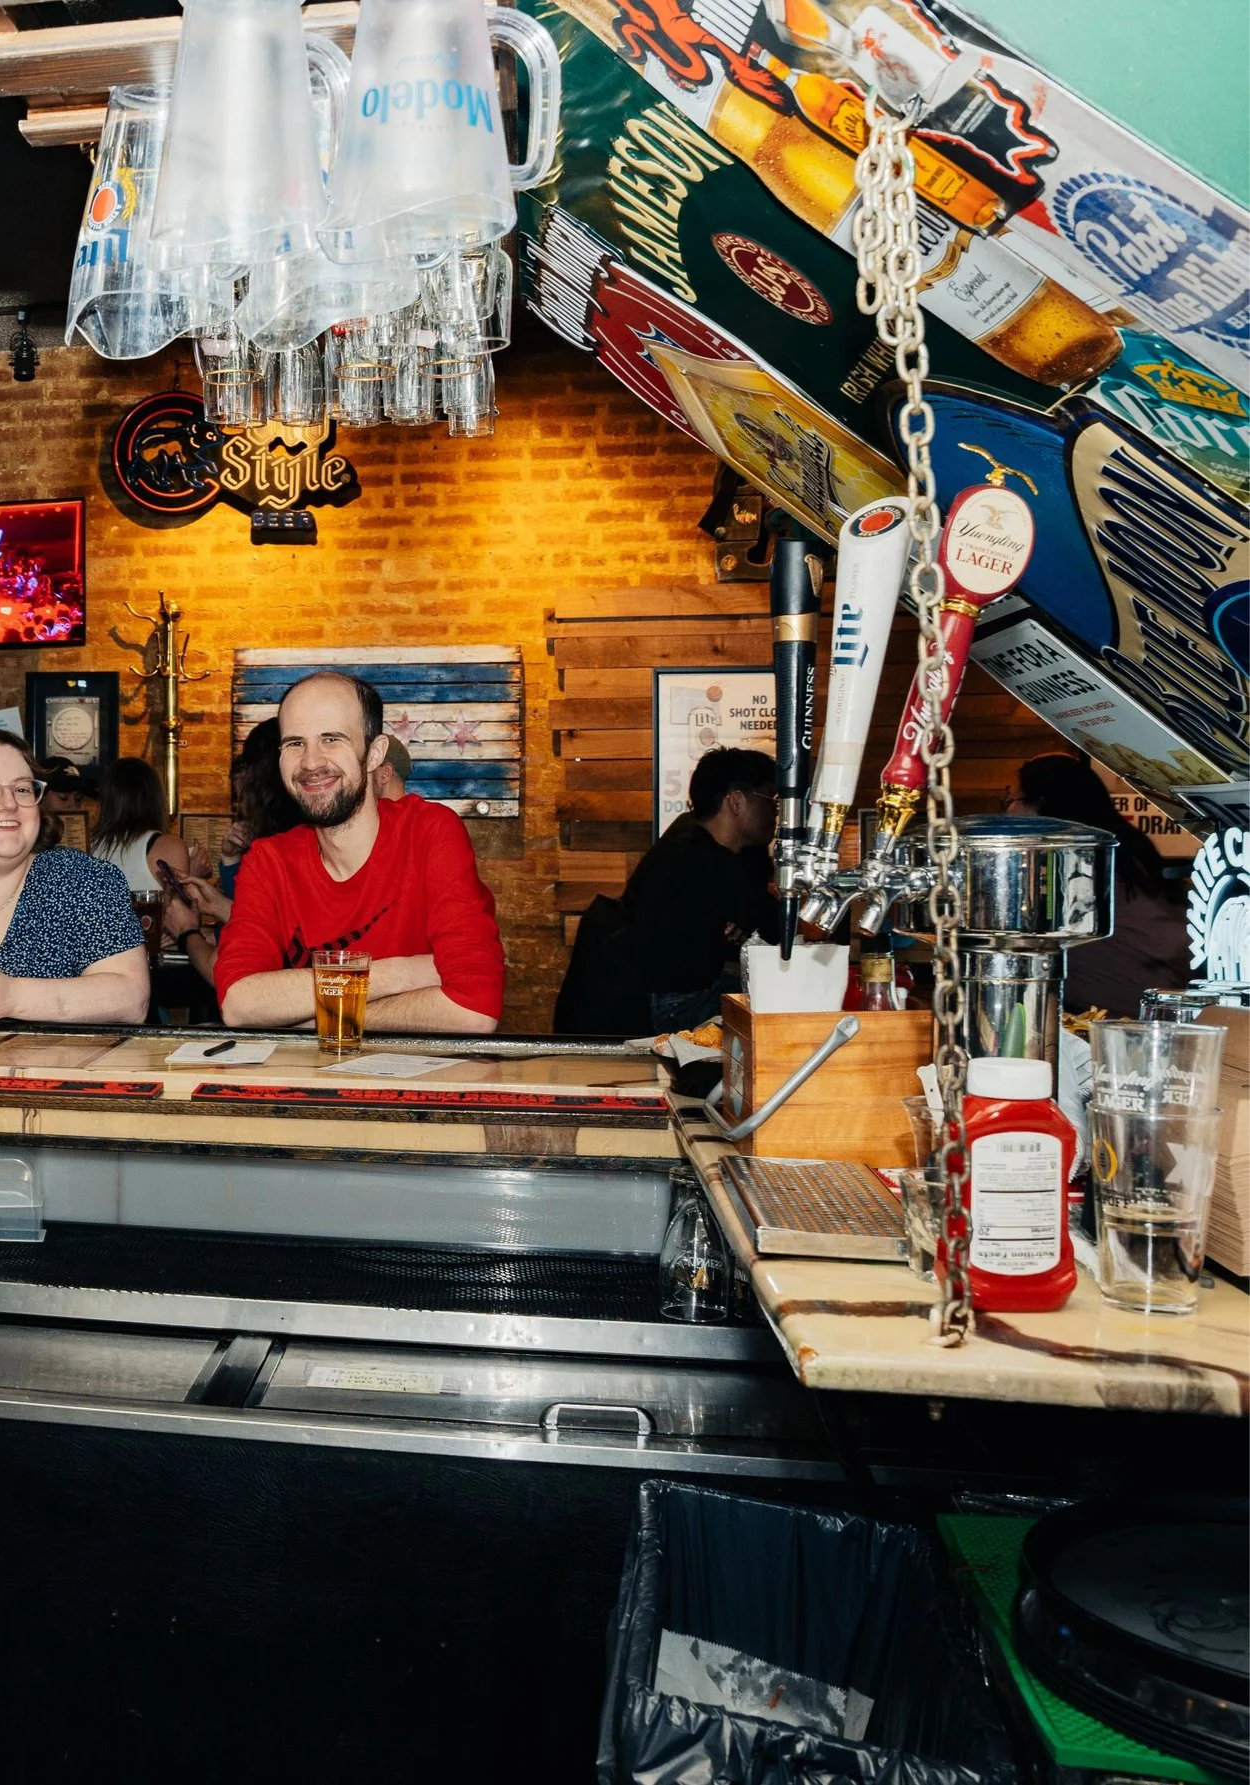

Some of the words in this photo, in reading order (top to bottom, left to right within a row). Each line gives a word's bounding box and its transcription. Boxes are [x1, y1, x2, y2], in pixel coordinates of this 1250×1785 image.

[362, 79, 495, 134] Modelo
[605, 100, 735, 303] JAMESON
[1075, 192, 1187, 281] Pabst
[839, 361, 882, 405] IRISH
[220, 435, 347, 510] Style
[252, 512, 312, 529] BEER
[952, 518, 1026, 553] Yuengling
[956, 548, 1013, 575] LAGER
[1096, 445, 1248, 645] MOON
[834, 602, 870, 669] Lite
[752, 695, 768, 705] NO
[1101, 596, 1250, 772] BLUE
[730, 707, 756, 718] SHOT
[758, 707, 777, 718] CLO
[801, 664, 817, 751] GUINNESS
[664, 769, 681, 797] 5
[1186, 831, 1227, 971] WHITE
[319, 988, 344, 997] LAGER
[1096, 1095, 1146, 1112] LAGER
[977, 1227, 990, 1236] 20
[977, 1251, 1008, 1260] Facts
